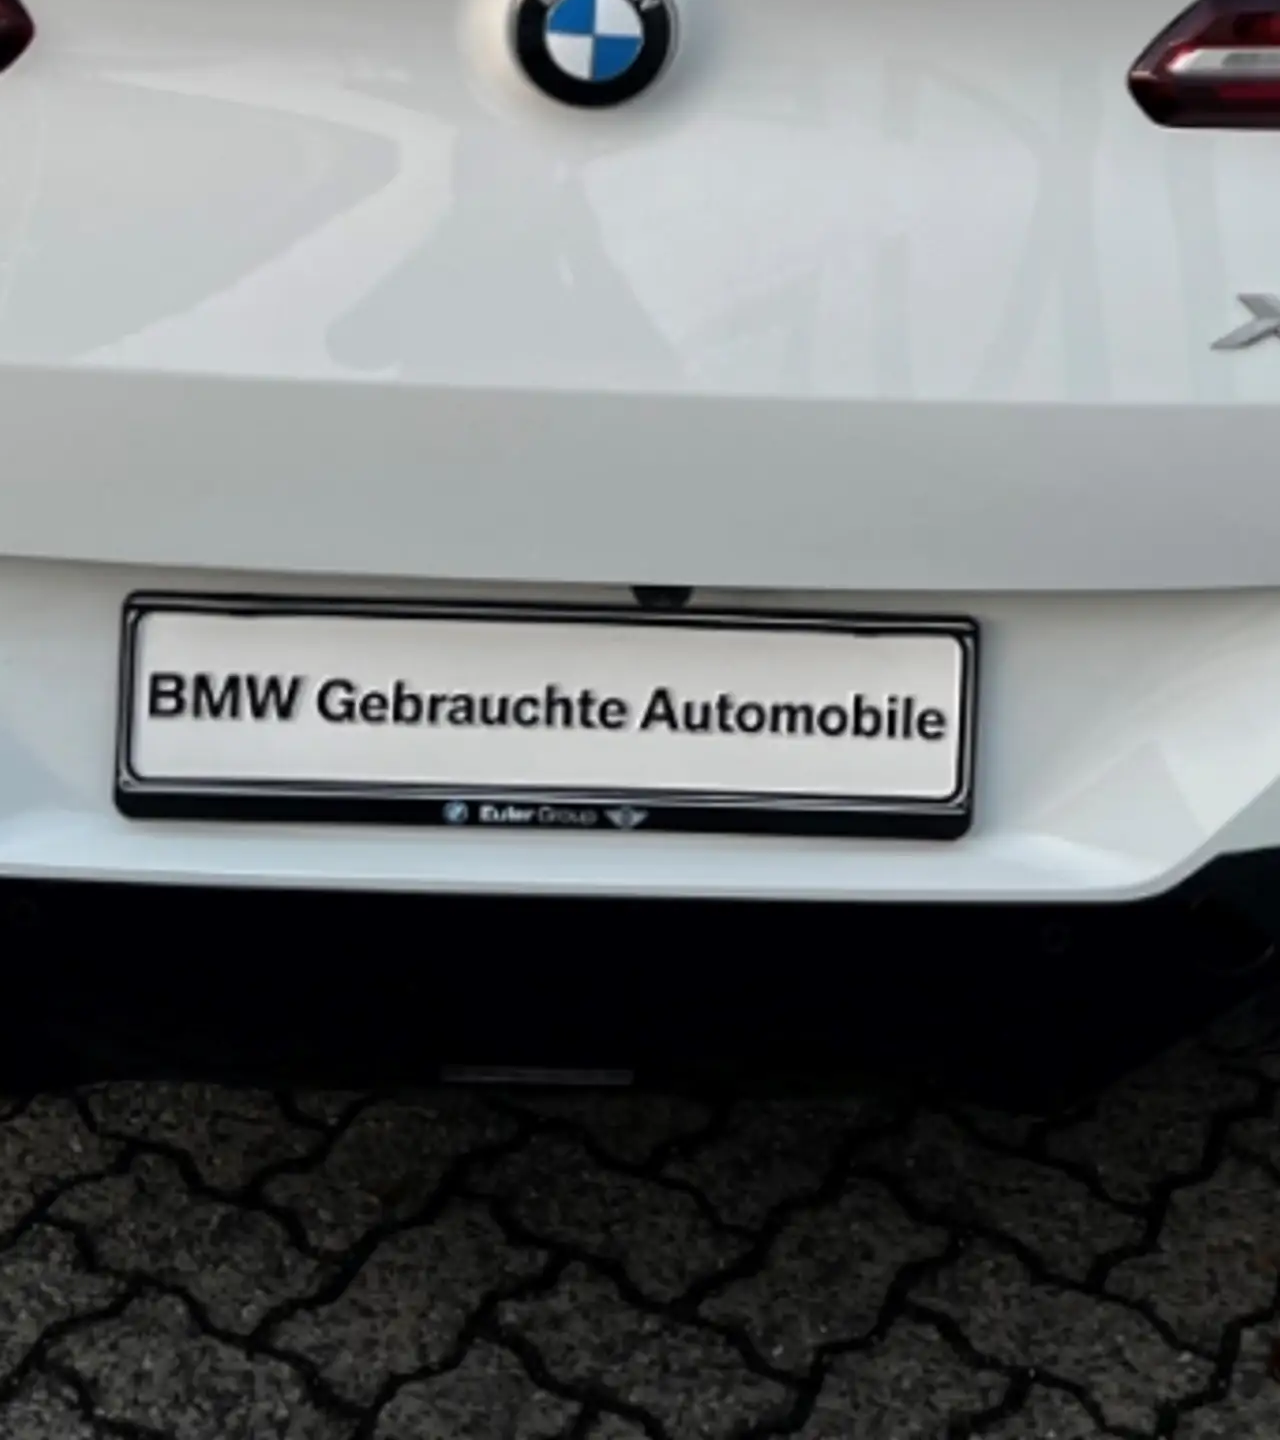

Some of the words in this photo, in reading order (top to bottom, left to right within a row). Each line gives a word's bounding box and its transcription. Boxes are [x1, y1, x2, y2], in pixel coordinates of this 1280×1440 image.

[148, 672, 301, 720] BMW
[316, 677, 628, 731] Gebrauchte
[638, 685, 948, 741] Automobile
[479, 804, 536, 824] Euler
